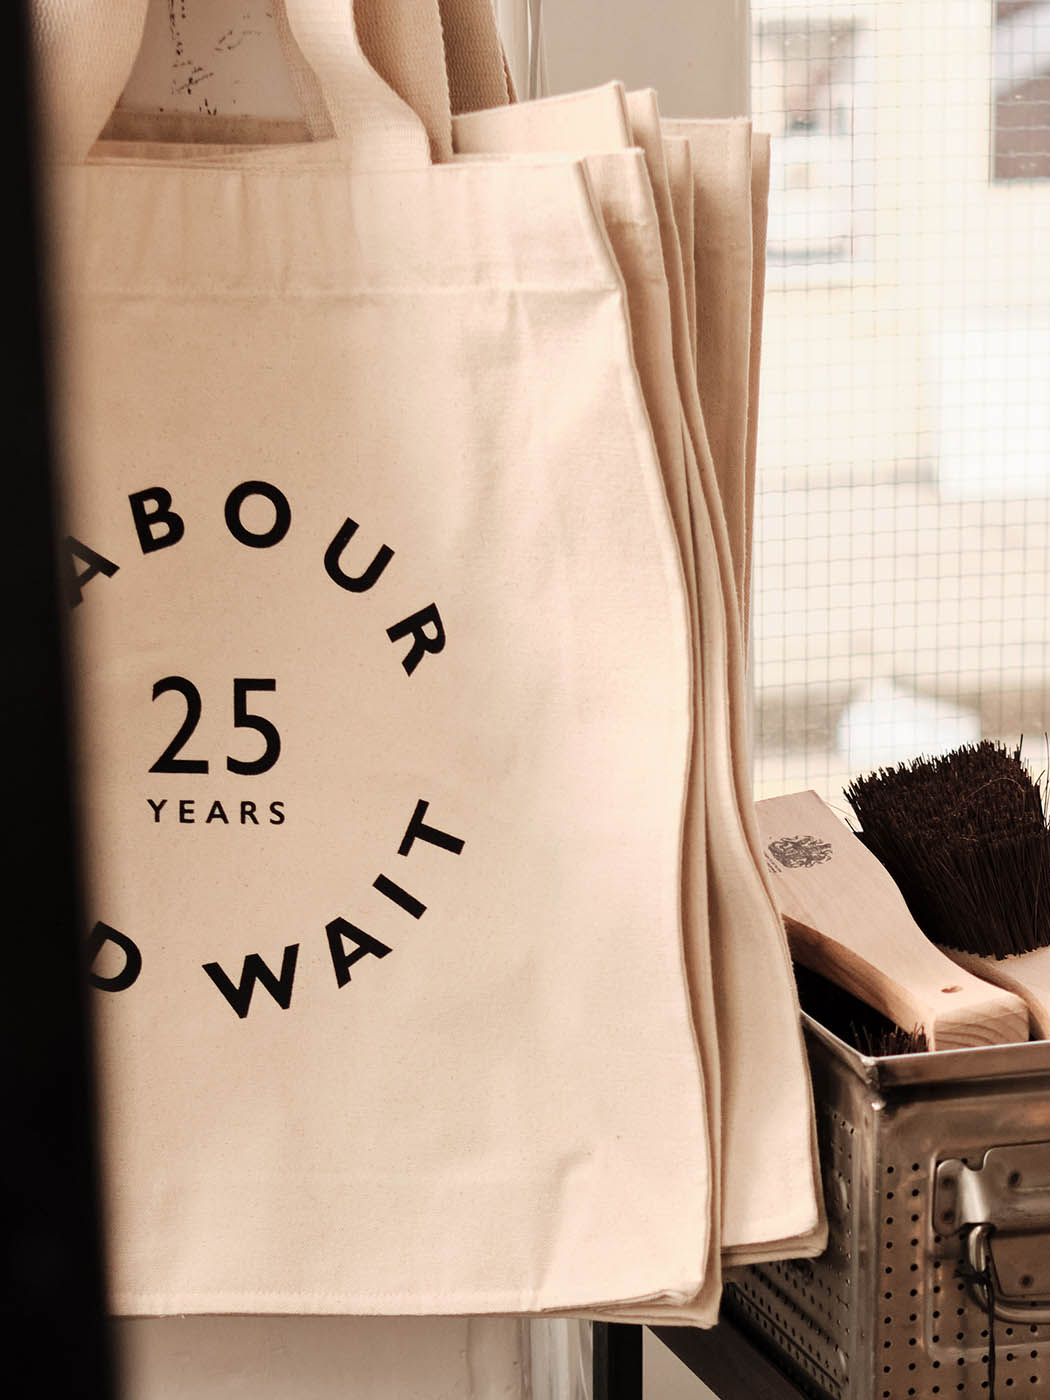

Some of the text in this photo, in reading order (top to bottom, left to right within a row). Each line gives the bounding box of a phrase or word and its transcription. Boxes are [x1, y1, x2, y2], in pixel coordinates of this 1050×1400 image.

[64, 480, 446, 677] ABOUR
[148, 676, 281, 775] 25
[147, 799, 285, 825] YEARS
[202, 799, 465, 1019] WAIT
